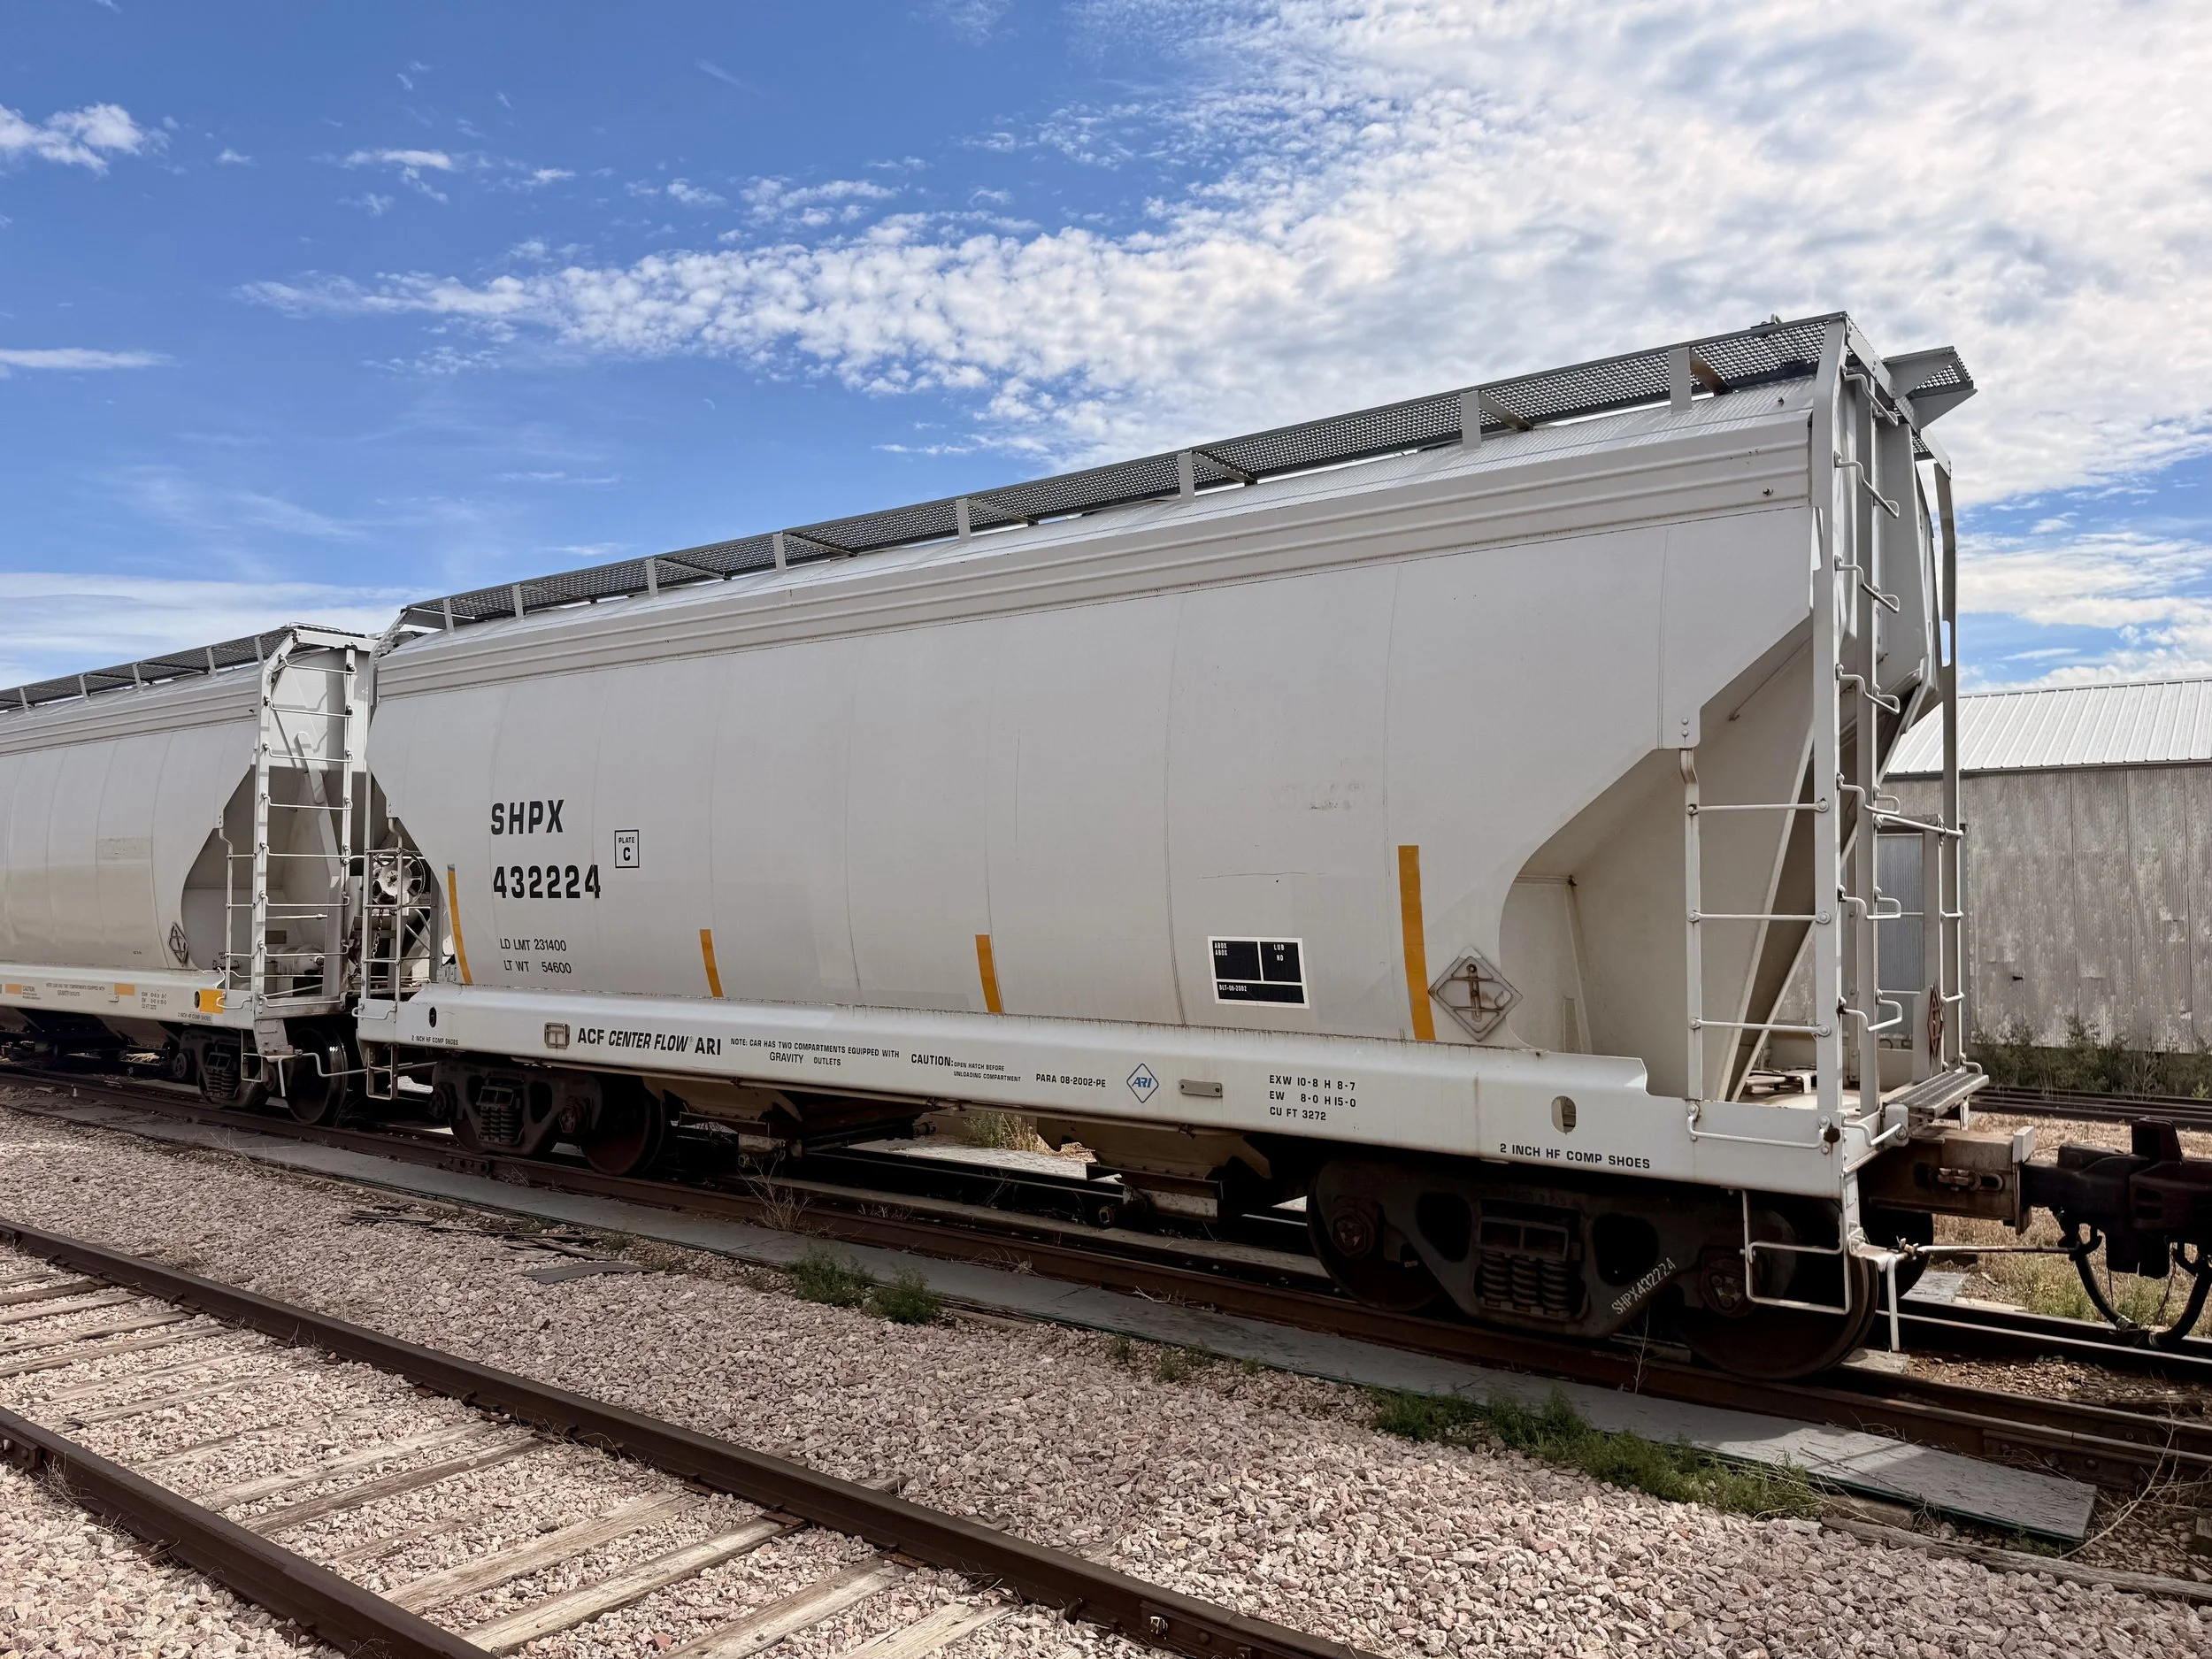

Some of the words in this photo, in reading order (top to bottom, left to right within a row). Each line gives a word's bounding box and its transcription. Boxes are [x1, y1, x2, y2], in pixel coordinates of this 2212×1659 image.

[490, 799, 565, 835] SHPX
[623, 847, 631, 861] C
[493, 864, 601, 899] 432224
[500, 938, 511, 949] LD
[513, 939, 530, 951] LMT
[534, 939, 567, 951] 231400
[503, 960, 512, 971] LT
[515, 960, 529, 972] WT
[541, 962, 572, 973] 54600
[578, 1028, 605, 1045] ACF
[609, 1030, 652, 1049] CENTER
[695, 1037, 721, 1056] ARI
[749, 1039, 762, 1048] CAR
[764, 1040, 776, 1048] HAS
[794, 1042, 846, 1054] COMPARTMENTS
[848, 1047, 879, 1056] EQUIPPED
[881, 1049, 900, 1058] WITH
[769, 1051, 803, 1064] GRAVITY
[814, 1056, 841, 1066] OUTLETS
[911, 1054, 954, 1067] CAUTION:
[983, 1073, 1021, 1082] COMPARTMENT
[1036, 1073, 1056, 1083] PARA
[1060, 1075, 1106, 1087] 08-2002-PE
[1131, 1077, 1152, 1088] ARI
[1269, 1075, 1292, 1085] EXW
[1325, 1079, 1331, 1088] H
[1269, 1091, 1285, 1100] EW
[1325, 1096, 1331, 1105] H
[1270, 1107, 1282, 1116] CU
[1286, 1109, 1297, 1118] FT
[1302, 1110, 1326, 1120] 3272
[1500, 1143, 1506, 1153] 2
[1512, 1145, 1540, 1157] INCH
[1546, 1148, 1560, 1159] HF
[1566, 1150, 1602, 1164] COMP
[1609, 1156, 1650, 1169] SHOES
[1611, 1257, 1677, 1315] SHPX432224
